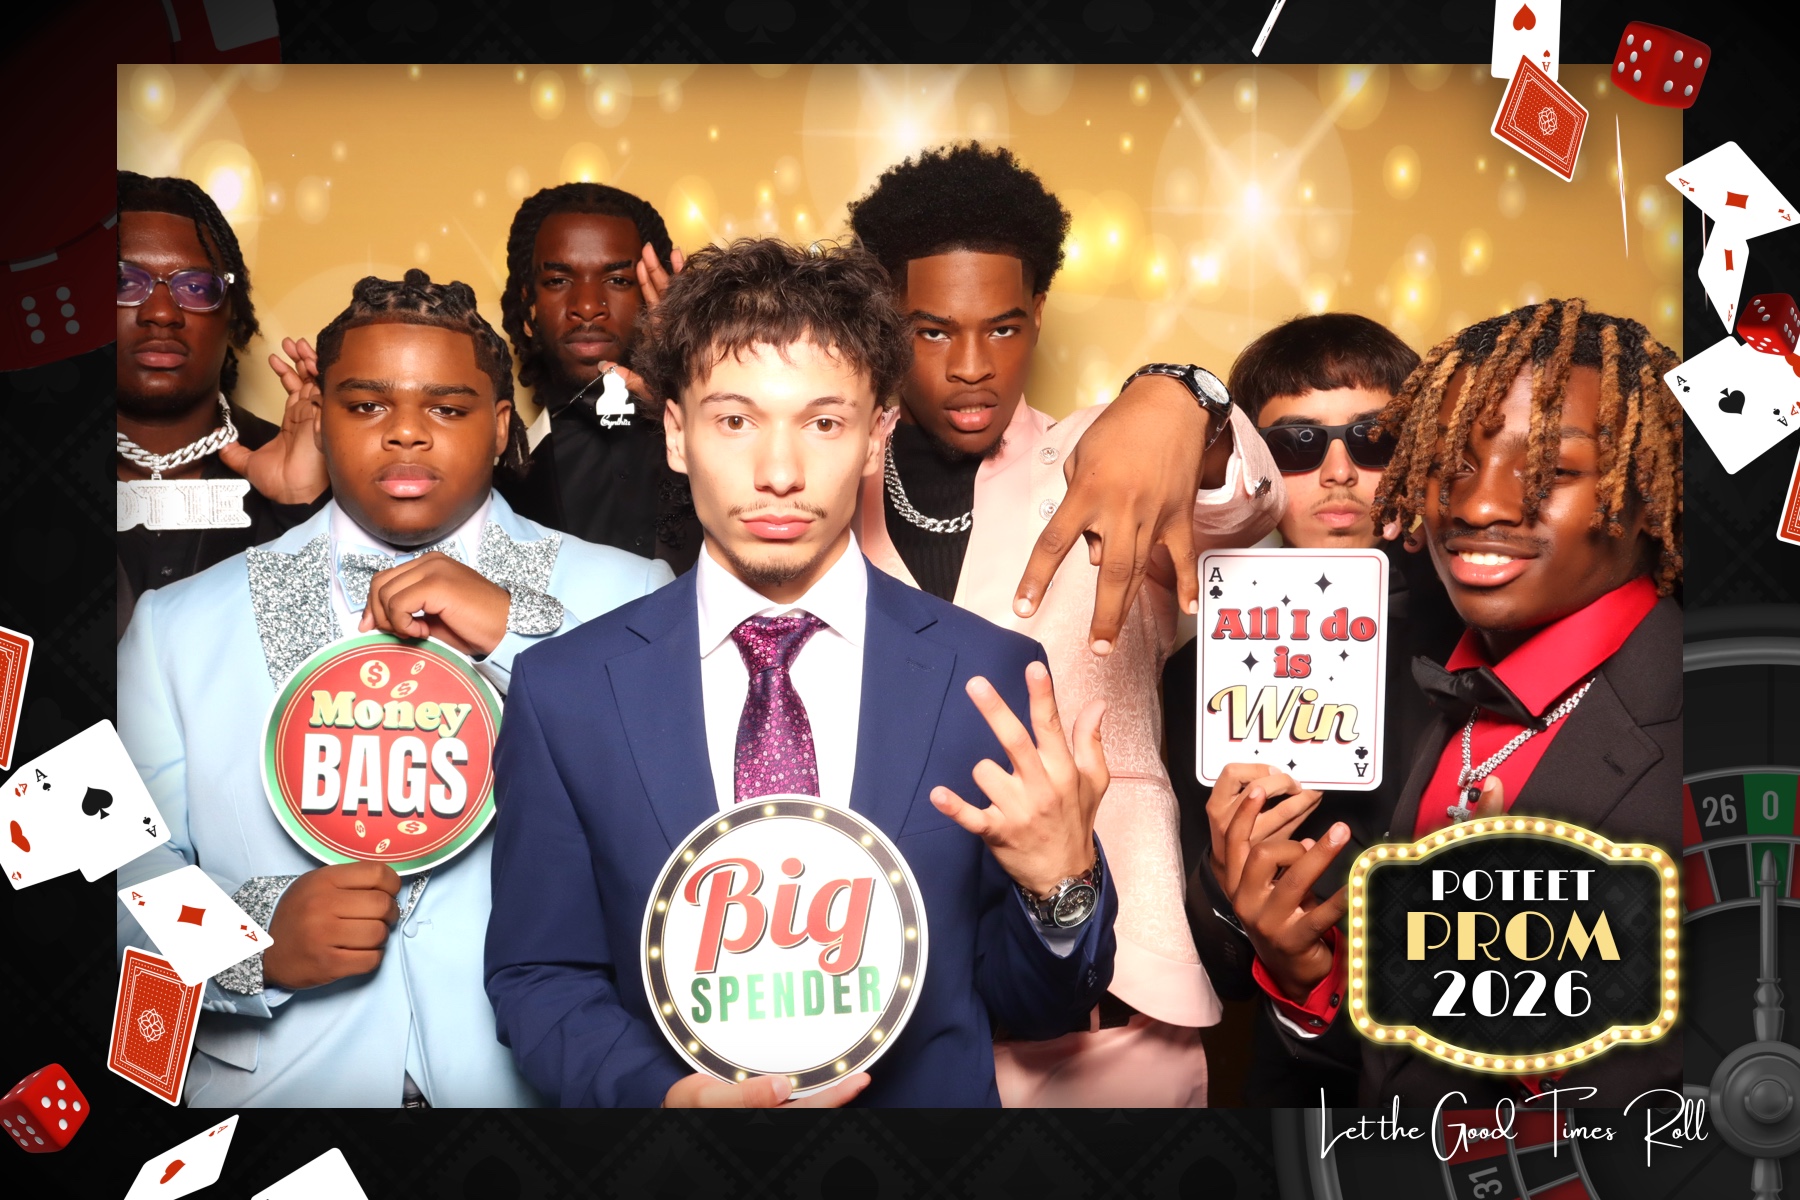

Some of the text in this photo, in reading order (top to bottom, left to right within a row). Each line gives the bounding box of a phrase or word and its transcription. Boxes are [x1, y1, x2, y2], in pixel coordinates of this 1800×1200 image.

[1208, 566, 1224, 583] A
[1211, 606, 1377, 641] All I do
[1273, 645, 1312, 679] is
[309, 690, 472, 738] Money
[1207, 685, 1360, 744] Win
[301, 733, 469, 820] BAGS
[1353, 762, 1369, 778] A
[684, 857, 876, 975] Big
[690, 965, 882, 1024] SPENDER
